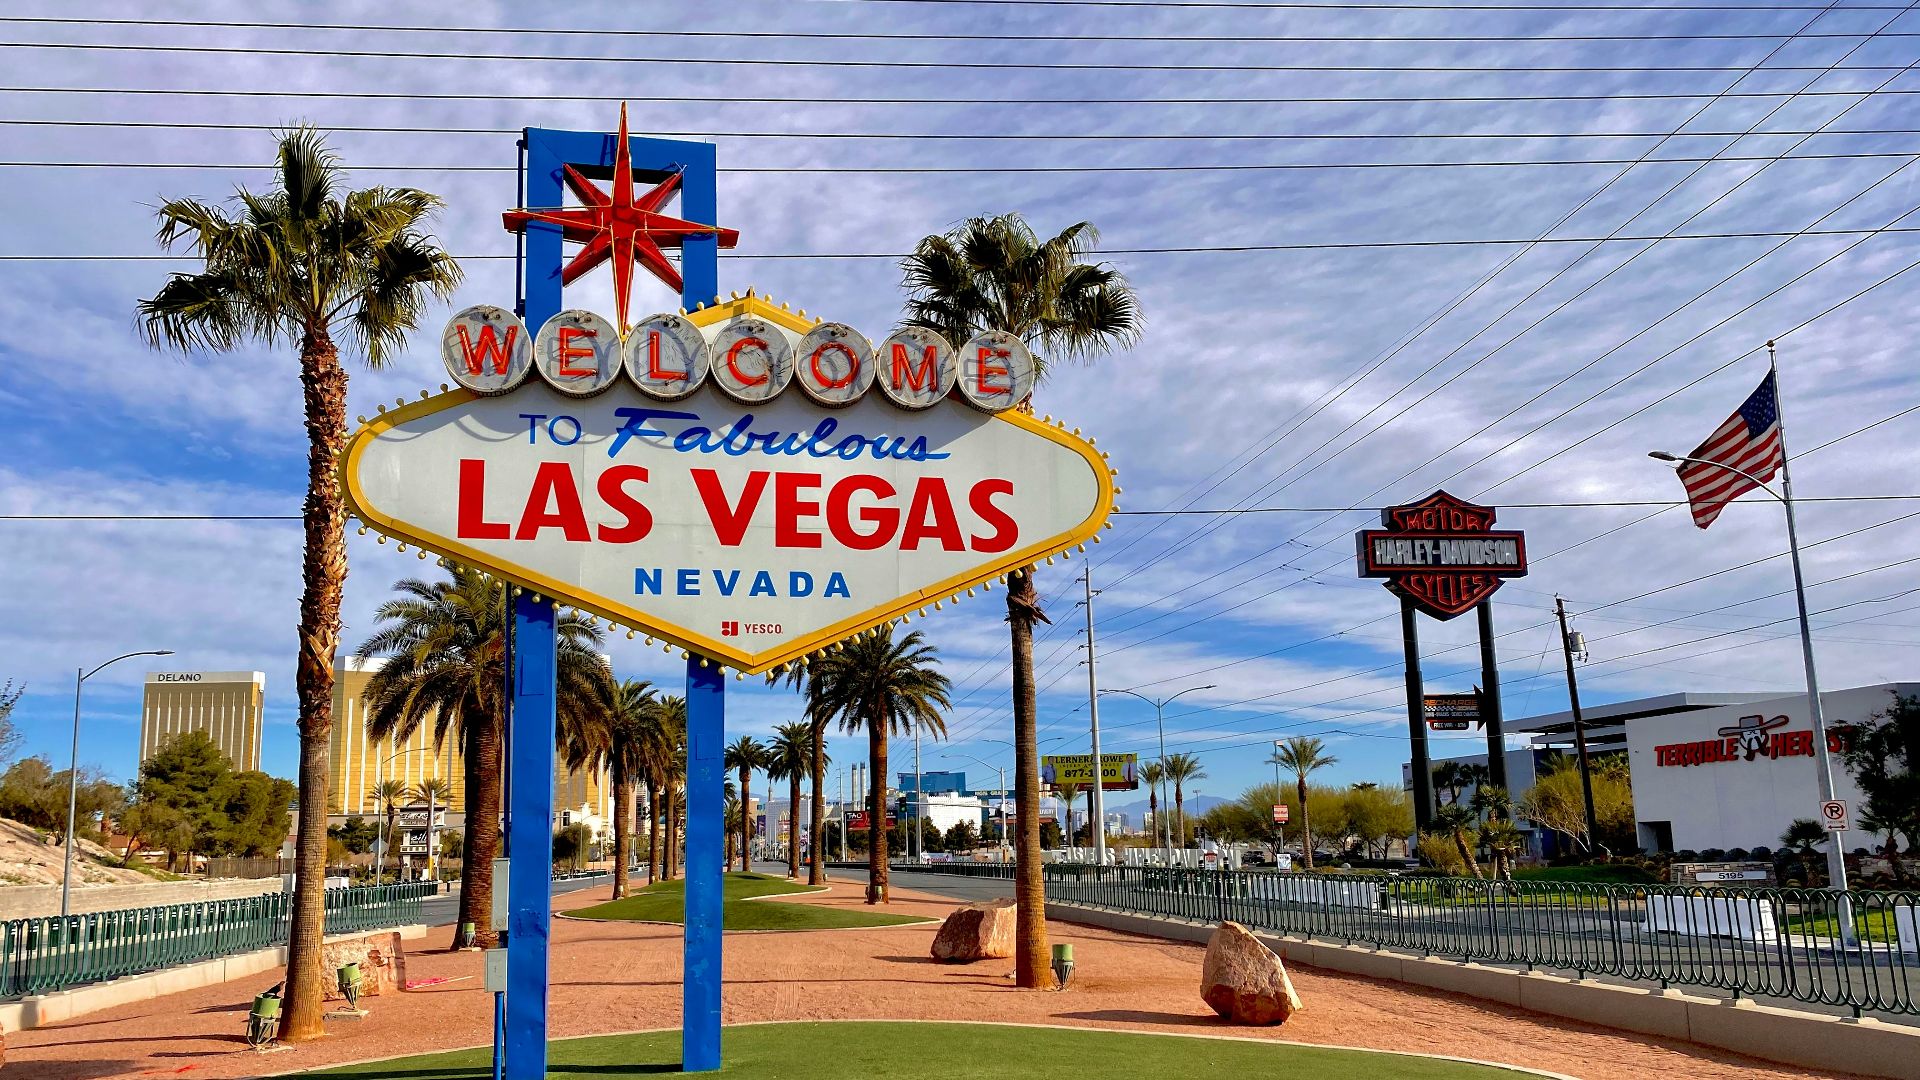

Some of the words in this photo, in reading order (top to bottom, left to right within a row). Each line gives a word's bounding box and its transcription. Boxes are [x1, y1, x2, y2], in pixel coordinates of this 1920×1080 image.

[453, 324, 1011, 393] WELCOME
[519, 413, 582, 446] TO
[608, 407, 951, 461] Fabulous
[457, 458, 653, 544] LAS
[690, 467, 1019, 553] VEGAS
[1406, 504, 1480, 531] MOTOR
[1374, 539, 1517, 565] HARLEY-DAVIDSON
[634, 567, 851, 598] NEVADA
[1410, 575, 1485, 607] CYCLES
[744, 623, 783, 635] YESCO
[157, 673, 202, 682] DELANO
[1055, 756, 1091, 764] LERNER
[1654, 737, 1741, 767] TERRIBLE
[1064, 769, 1117, 778] 877-100
[846, 812, 863, 820] TAO
[1718, 872, 1745, 880] 5195
